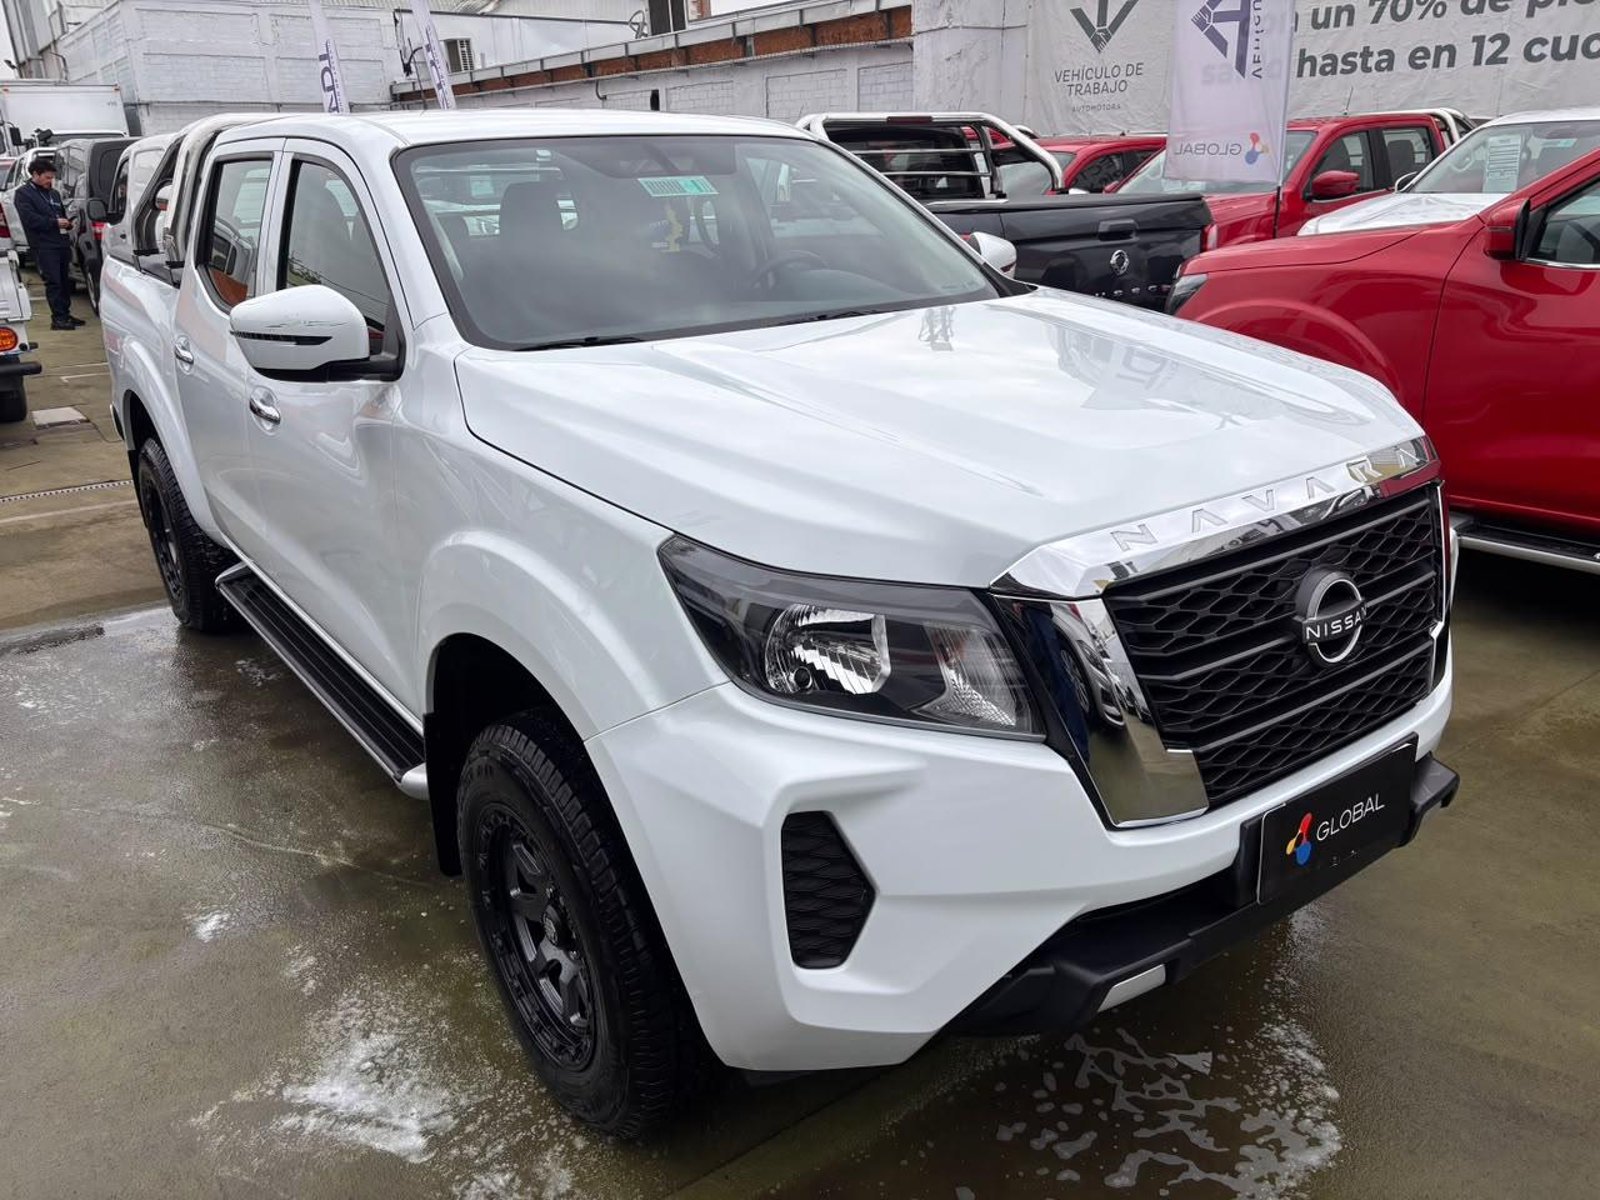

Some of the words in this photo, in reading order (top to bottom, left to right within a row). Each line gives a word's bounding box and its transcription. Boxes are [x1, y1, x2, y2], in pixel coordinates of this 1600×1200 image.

[1311, 5, 1356, 30] un
[1055, 64, 1121, 83] VEHÍCULO
[1126, 62, 1144, 77] DE
[1297, 47, 1396, 78] hasta
[1408, 43, 1457, 71] en
[1471, 33, 1511, 67] 12
[1066, 80, 1128, 96] TRABAJO
[1111, 447, 1420, 551] NAVARA
[1316, 793, 1385, 841] GLOBAL
